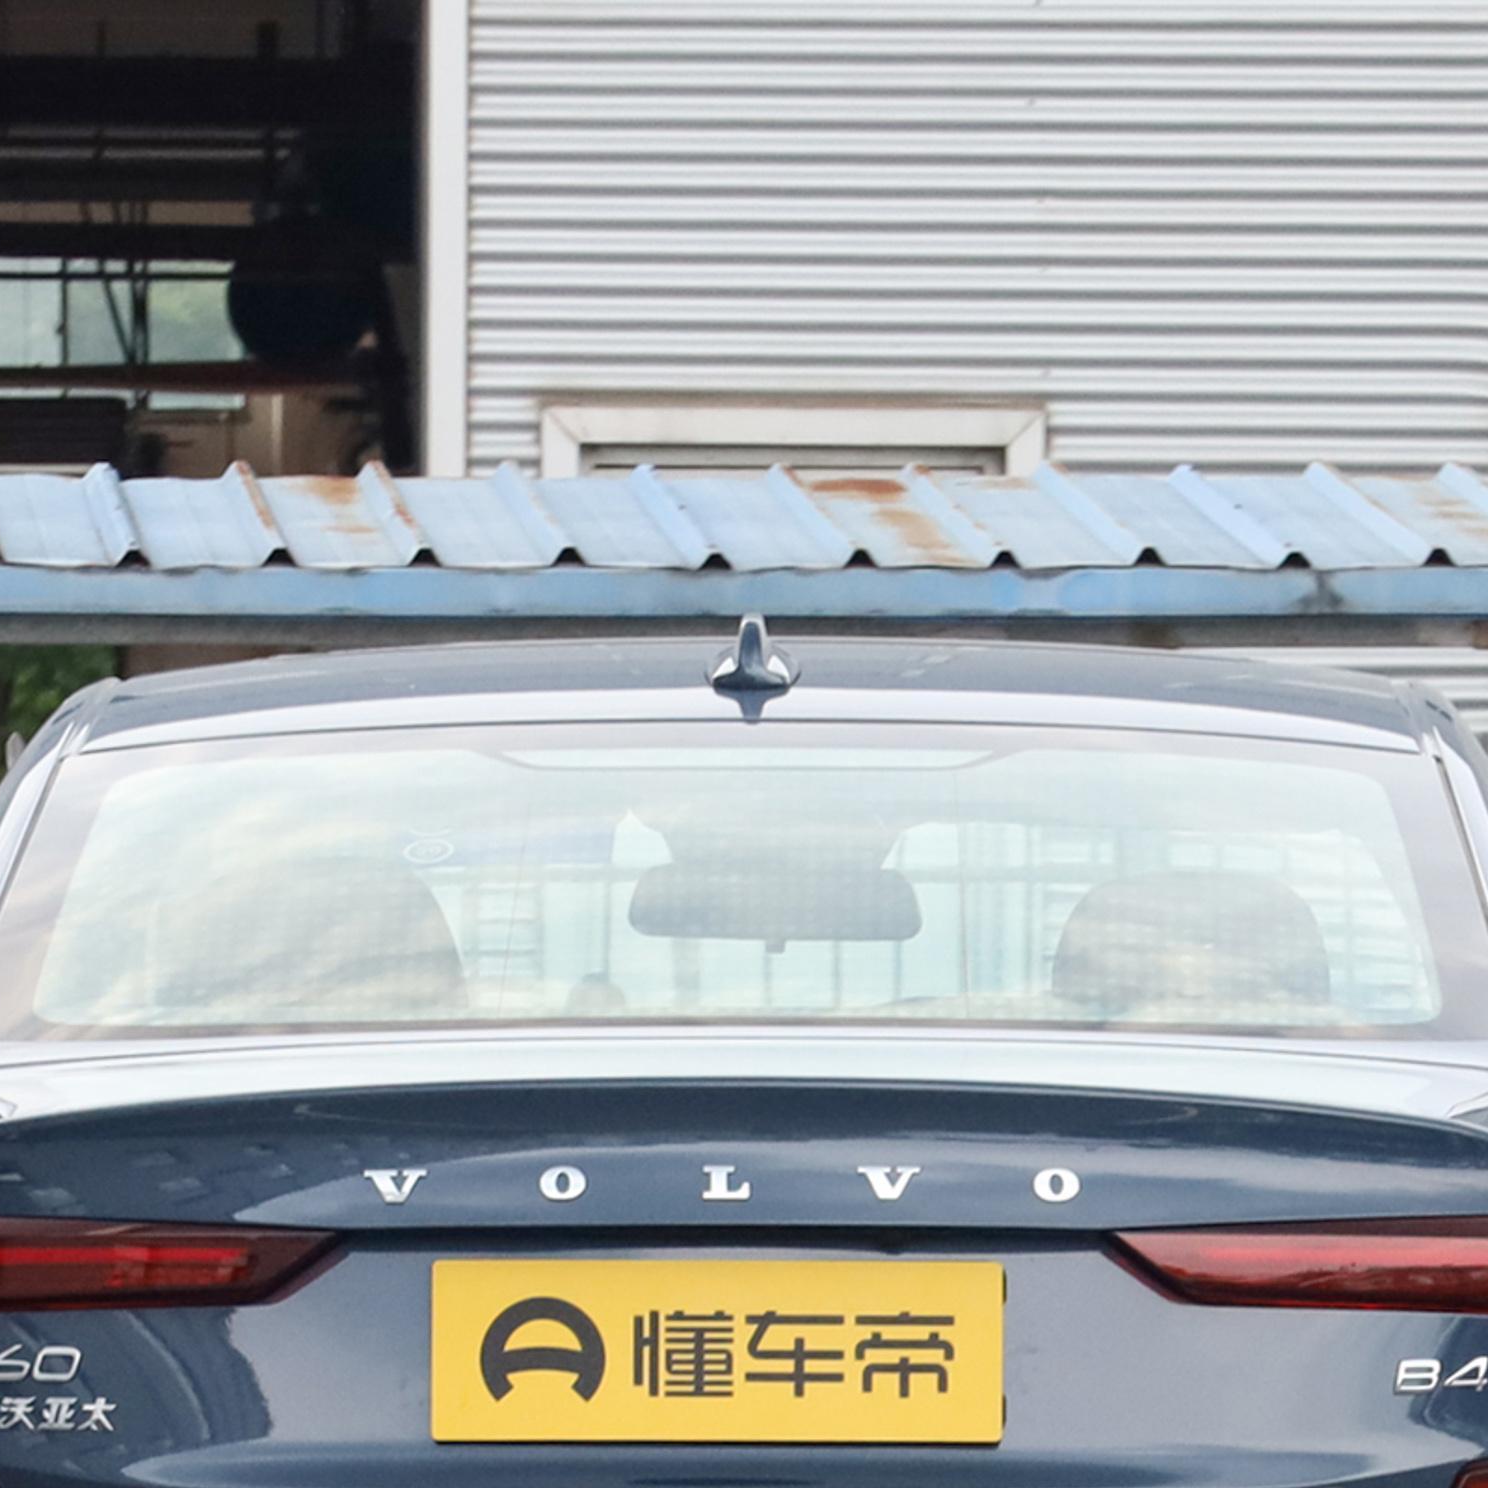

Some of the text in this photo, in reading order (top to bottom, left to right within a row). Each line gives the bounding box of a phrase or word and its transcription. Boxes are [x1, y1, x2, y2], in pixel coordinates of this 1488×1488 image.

[364, 1165, 1081, 1203] VOLVO
[633, 1310, 955, 1399] 懂车帝
[1395, 1356, 1488, 1393] B4
